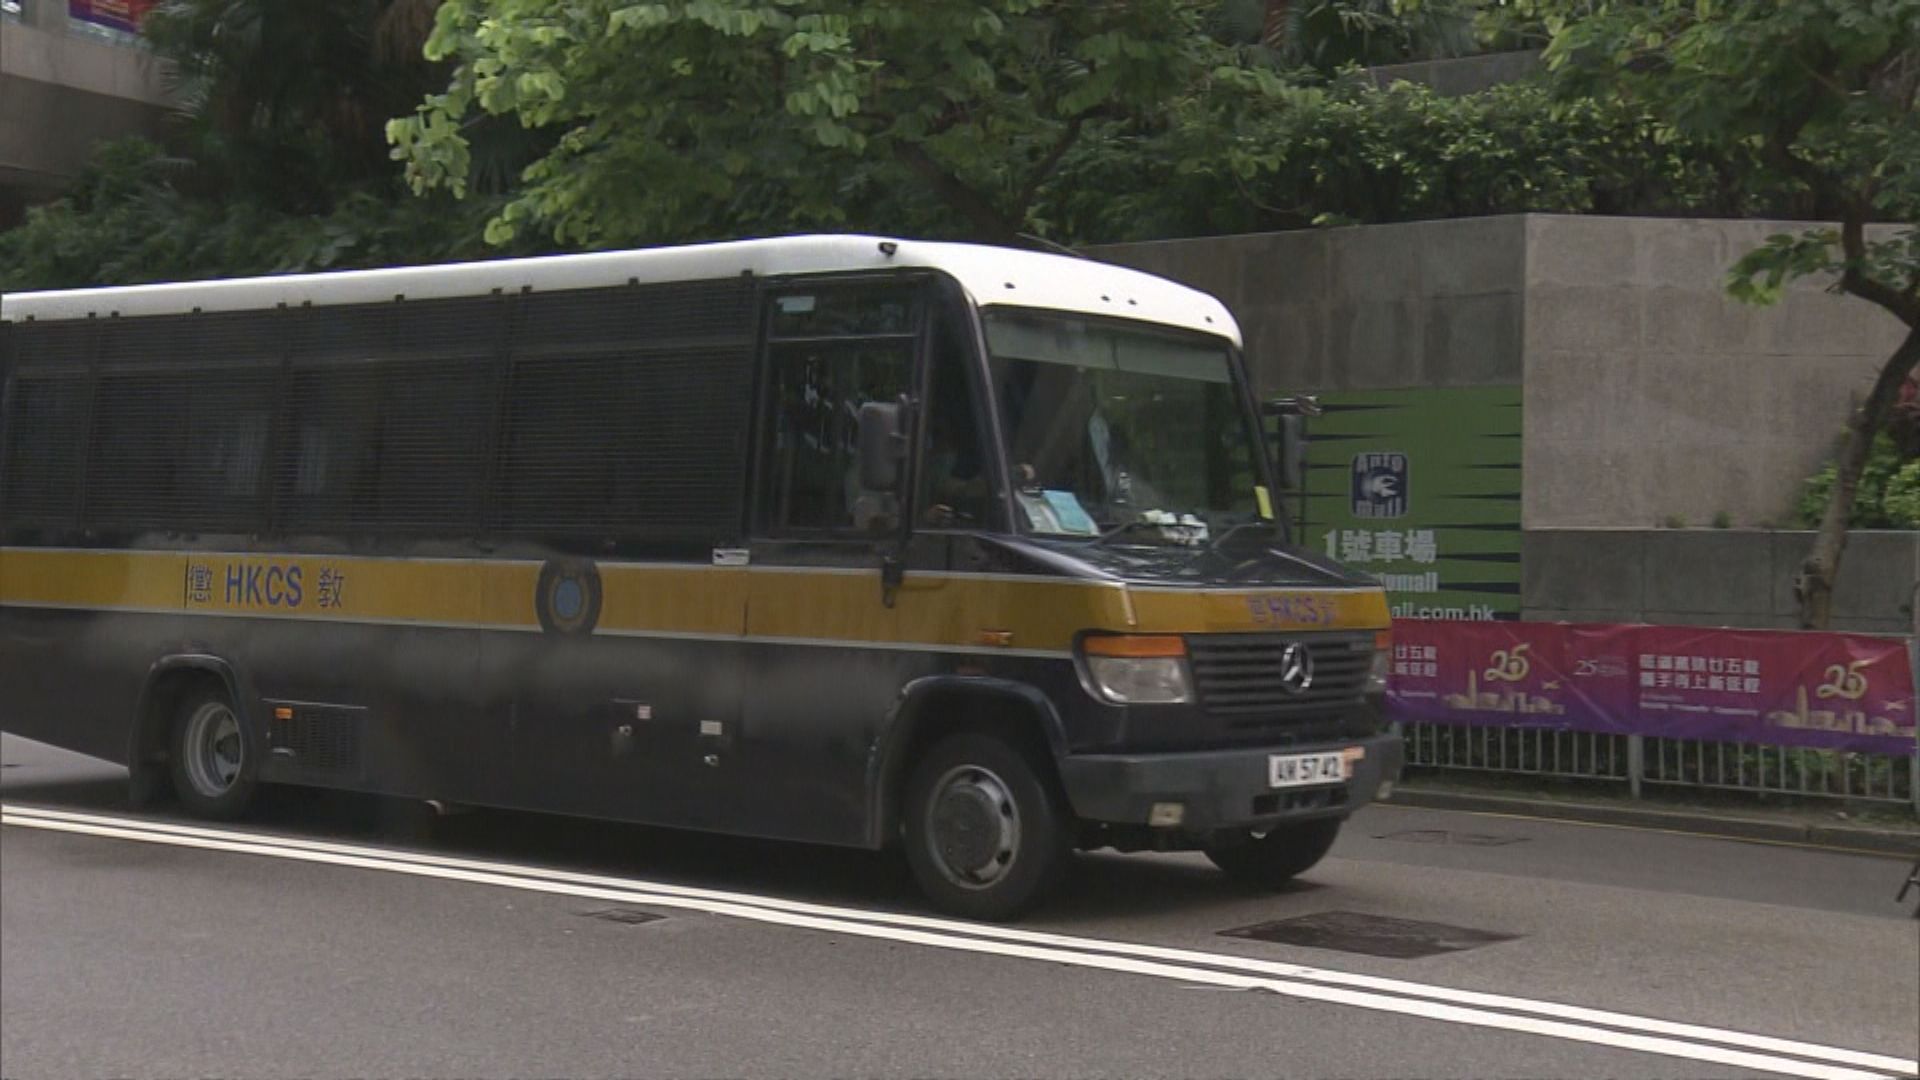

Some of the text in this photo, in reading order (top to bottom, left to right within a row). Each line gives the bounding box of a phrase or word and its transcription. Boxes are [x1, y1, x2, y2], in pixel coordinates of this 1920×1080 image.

[1356, 496, 1401, 518] mall
[1322, 529, 1437, 563] 1號車場
[225, 563, 303, 607] HKCS
[1391, 602, 1496, 621] all.com.hk
[1483, 643, 1531, 682] 25
[1816, 656, 1869, 700] 25
